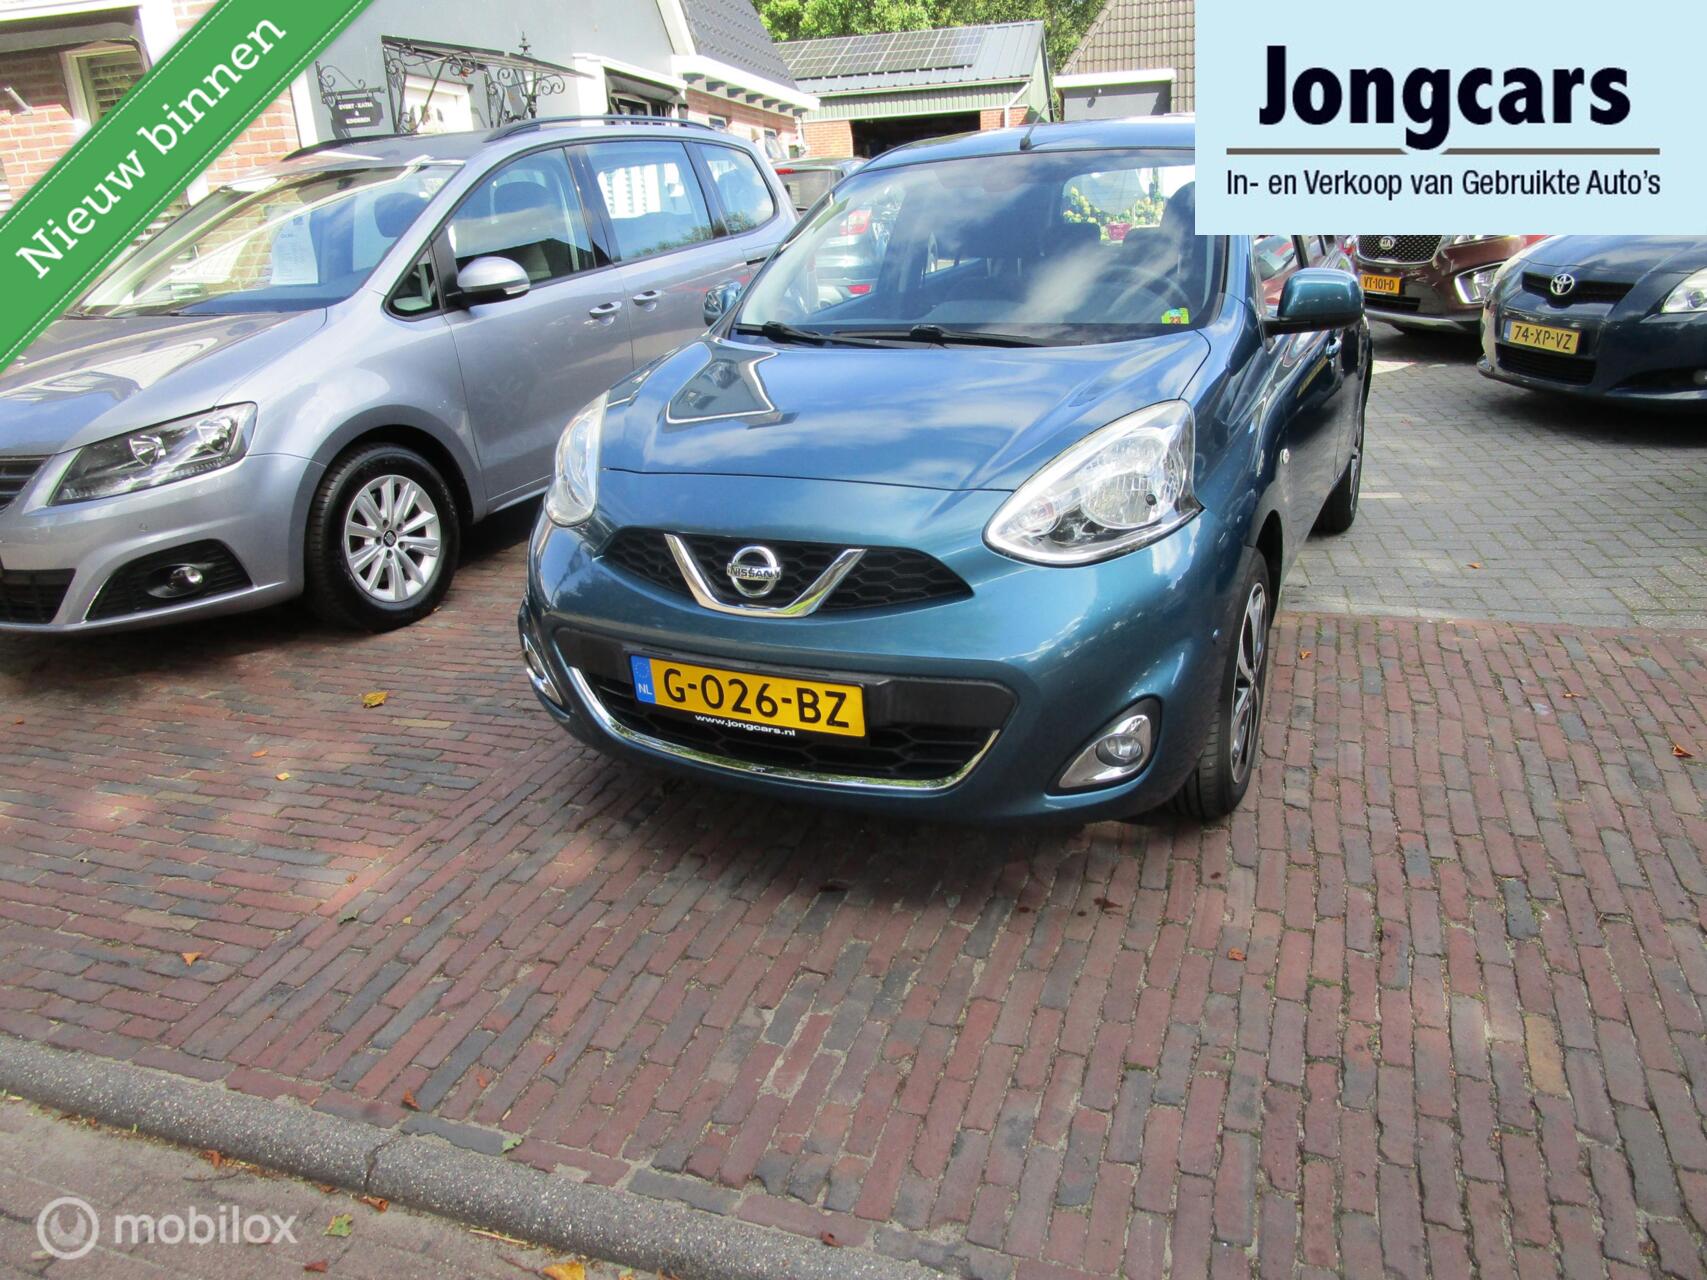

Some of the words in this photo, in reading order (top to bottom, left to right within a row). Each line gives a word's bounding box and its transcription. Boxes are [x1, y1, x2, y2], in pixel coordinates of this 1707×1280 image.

[1514, 325, 1573, 350] 74-XP-VZ
[729, 565, 776, 579] NISSAN
[638, 683, 652, 696] NL
[663, 668, 850, 728] G-026-BZ
[695, 714, 796, 737] www.jongcars.nl
